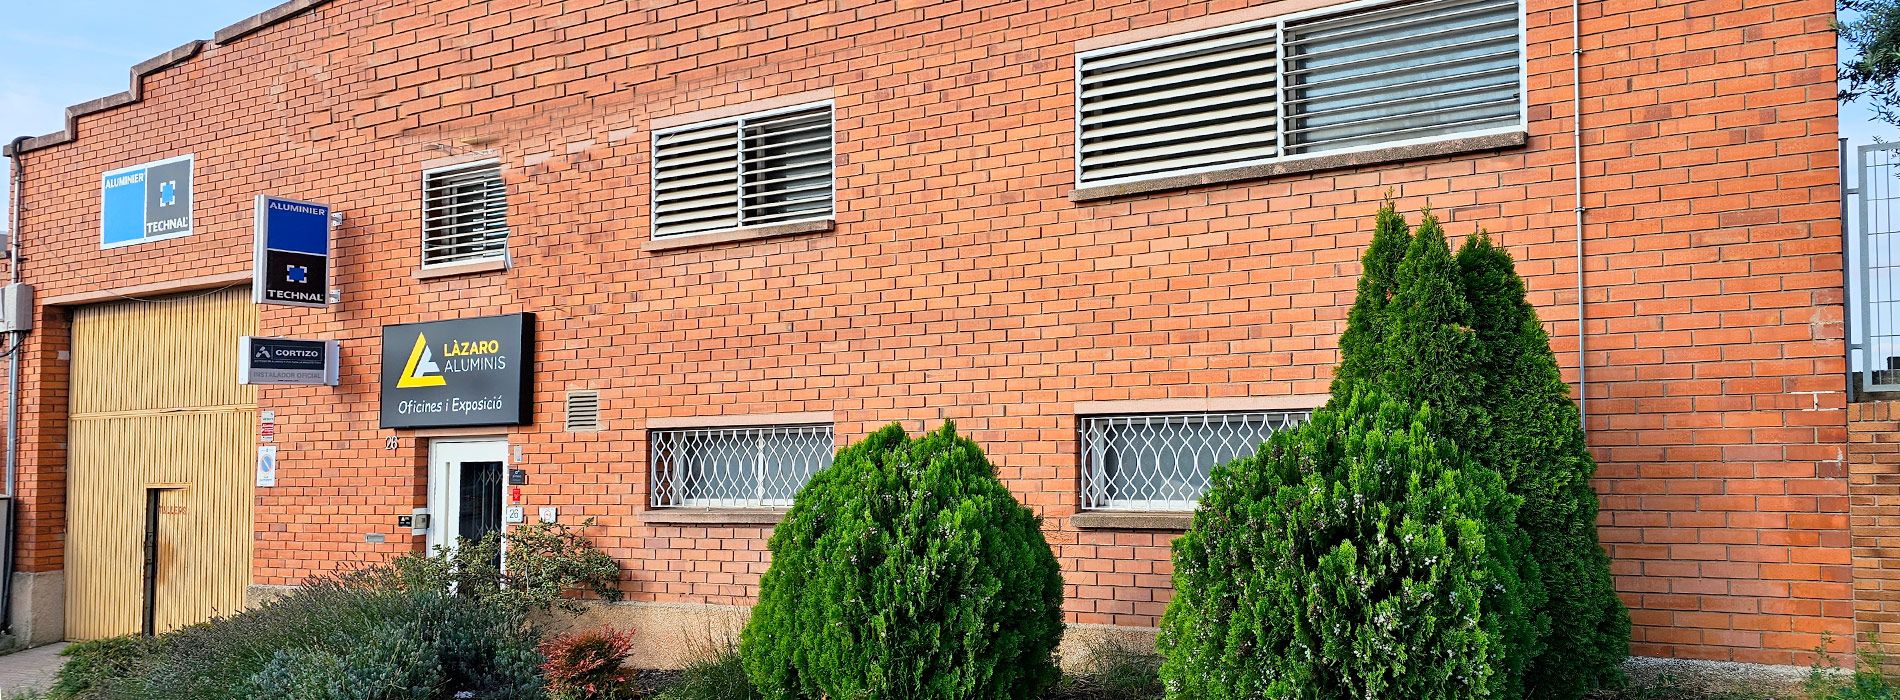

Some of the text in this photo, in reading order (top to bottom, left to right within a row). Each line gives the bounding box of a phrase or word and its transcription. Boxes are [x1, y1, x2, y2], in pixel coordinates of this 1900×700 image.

[105, 173, 144, 189] ALUMINIER
[269, 202, 326, 216] ALUMINIER
[147, 217, 188, 233] TECHNAL
[267, 289, 324, 301] TECHNAL
[275, 349, 319, 357] CORTIZO
[443, 339, 499, 357] LÀZARO
[444, 356, 506, 373] ALUMINIS
[398, 399, 442, 414] Oficines
[452, 395, 503, 415] Exposició
[385, 435, 398, 450] 26
[509, 509, 519, 519] 26
